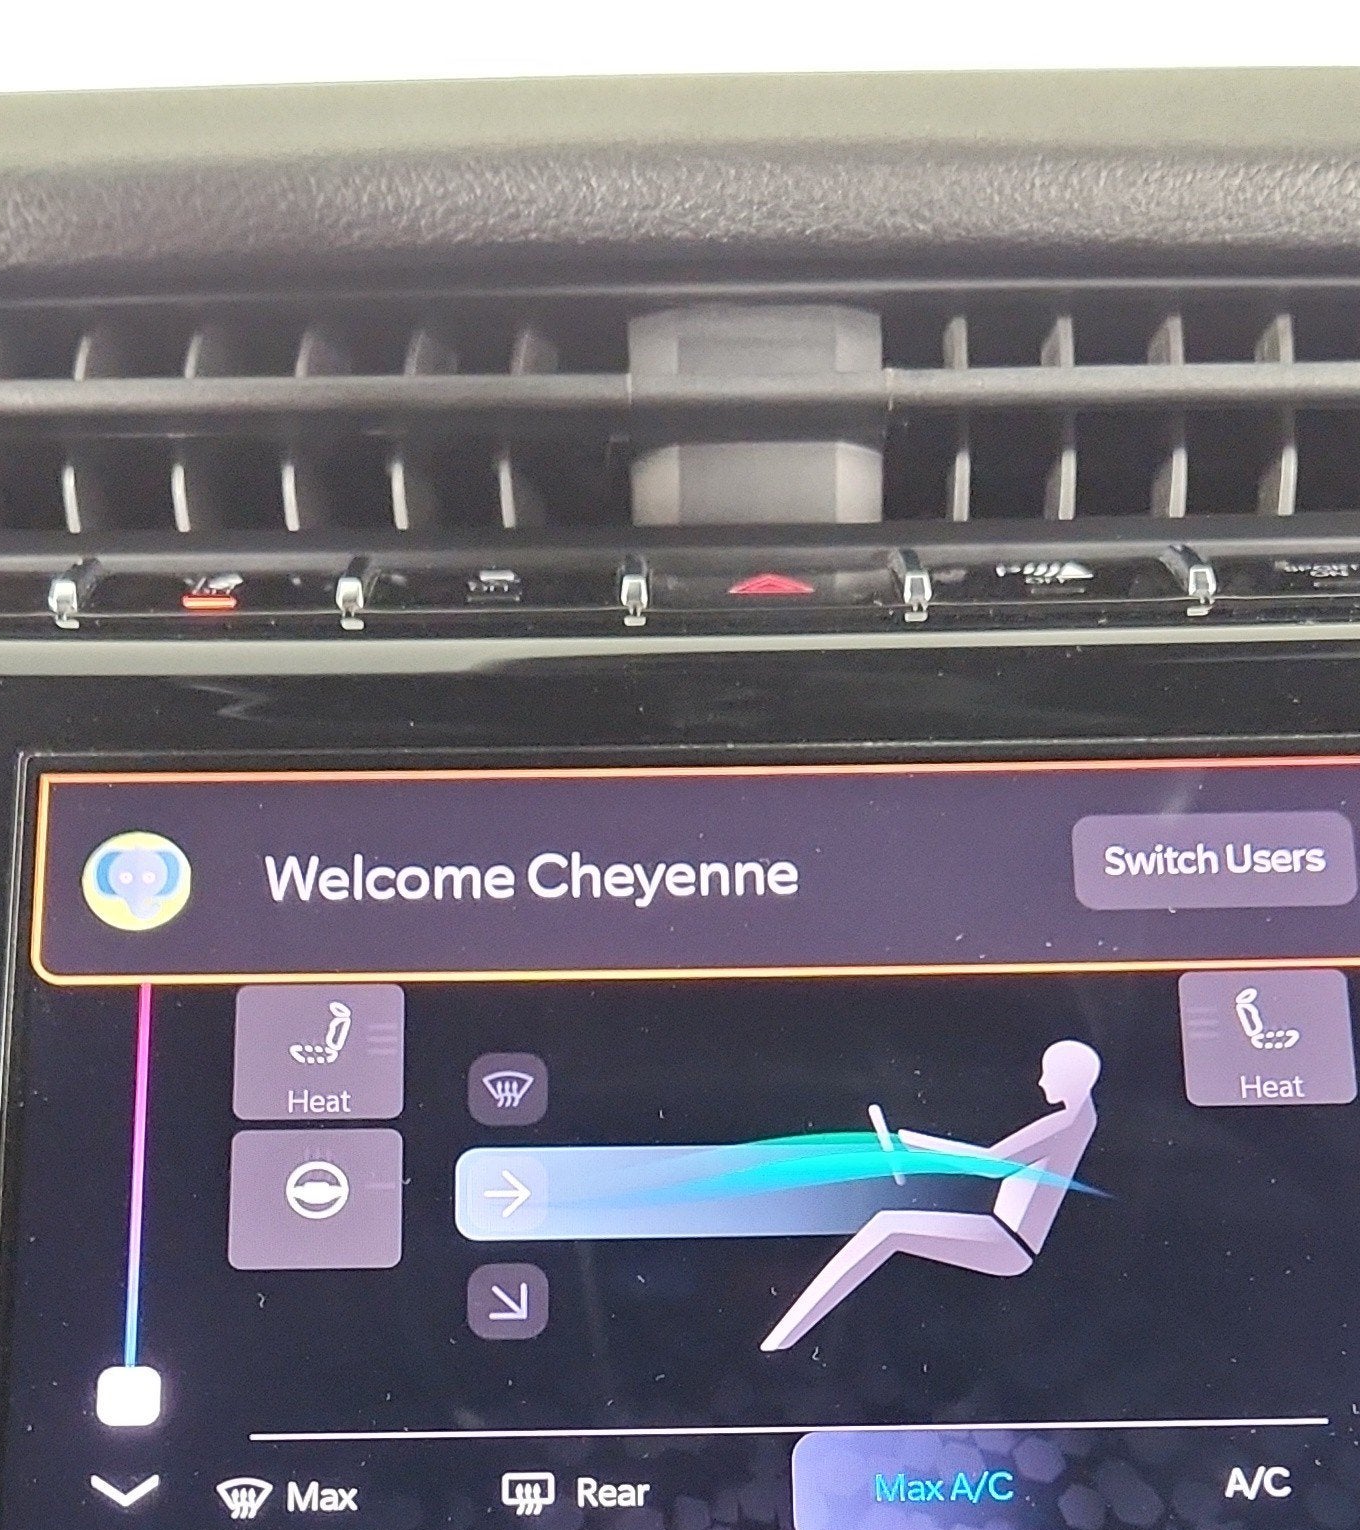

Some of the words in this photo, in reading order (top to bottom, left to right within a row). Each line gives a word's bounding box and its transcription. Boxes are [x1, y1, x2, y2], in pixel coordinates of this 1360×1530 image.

[1105, 843, 1219, 876] Switch
[1225, 843, 1326, 874] Users
[265, 853, 515, 902] Welcome
[527, 851, 798, 908] Cheyenne
[288, 1089, 351, 1113] Heat
[1240, 1075, 1305, 1099] Heat
[287, 1481, 358, 1512] Max
[577, 1477, 651, 1508] Rear
[874, 1472, 945, 1503] Max
[949, 1469, 1015, 1504] A/C
[1224, 1465, 1292, 1500] A/C
